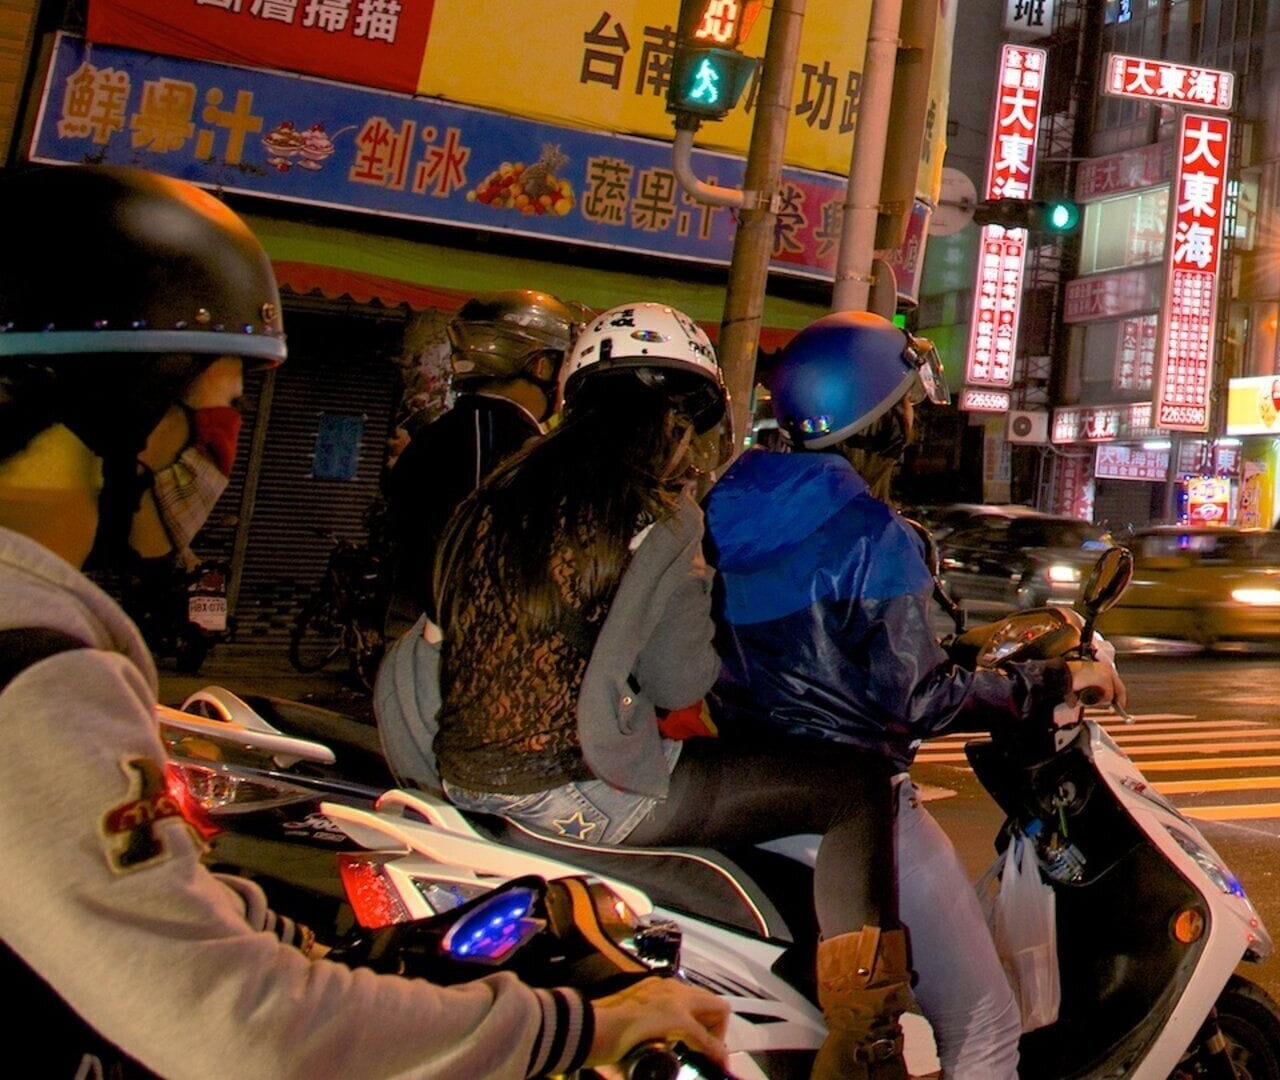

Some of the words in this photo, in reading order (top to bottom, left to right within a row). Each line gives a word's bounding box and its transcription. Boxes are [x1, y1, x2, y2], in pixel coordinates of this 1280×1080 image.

[1126, 61, 1218, 104] 大東海
[1174, 121, 1224, 270] 大東海
[965, 393, 1009, 410] 2265596
[1161, 406, 1205, 425] 2265596
